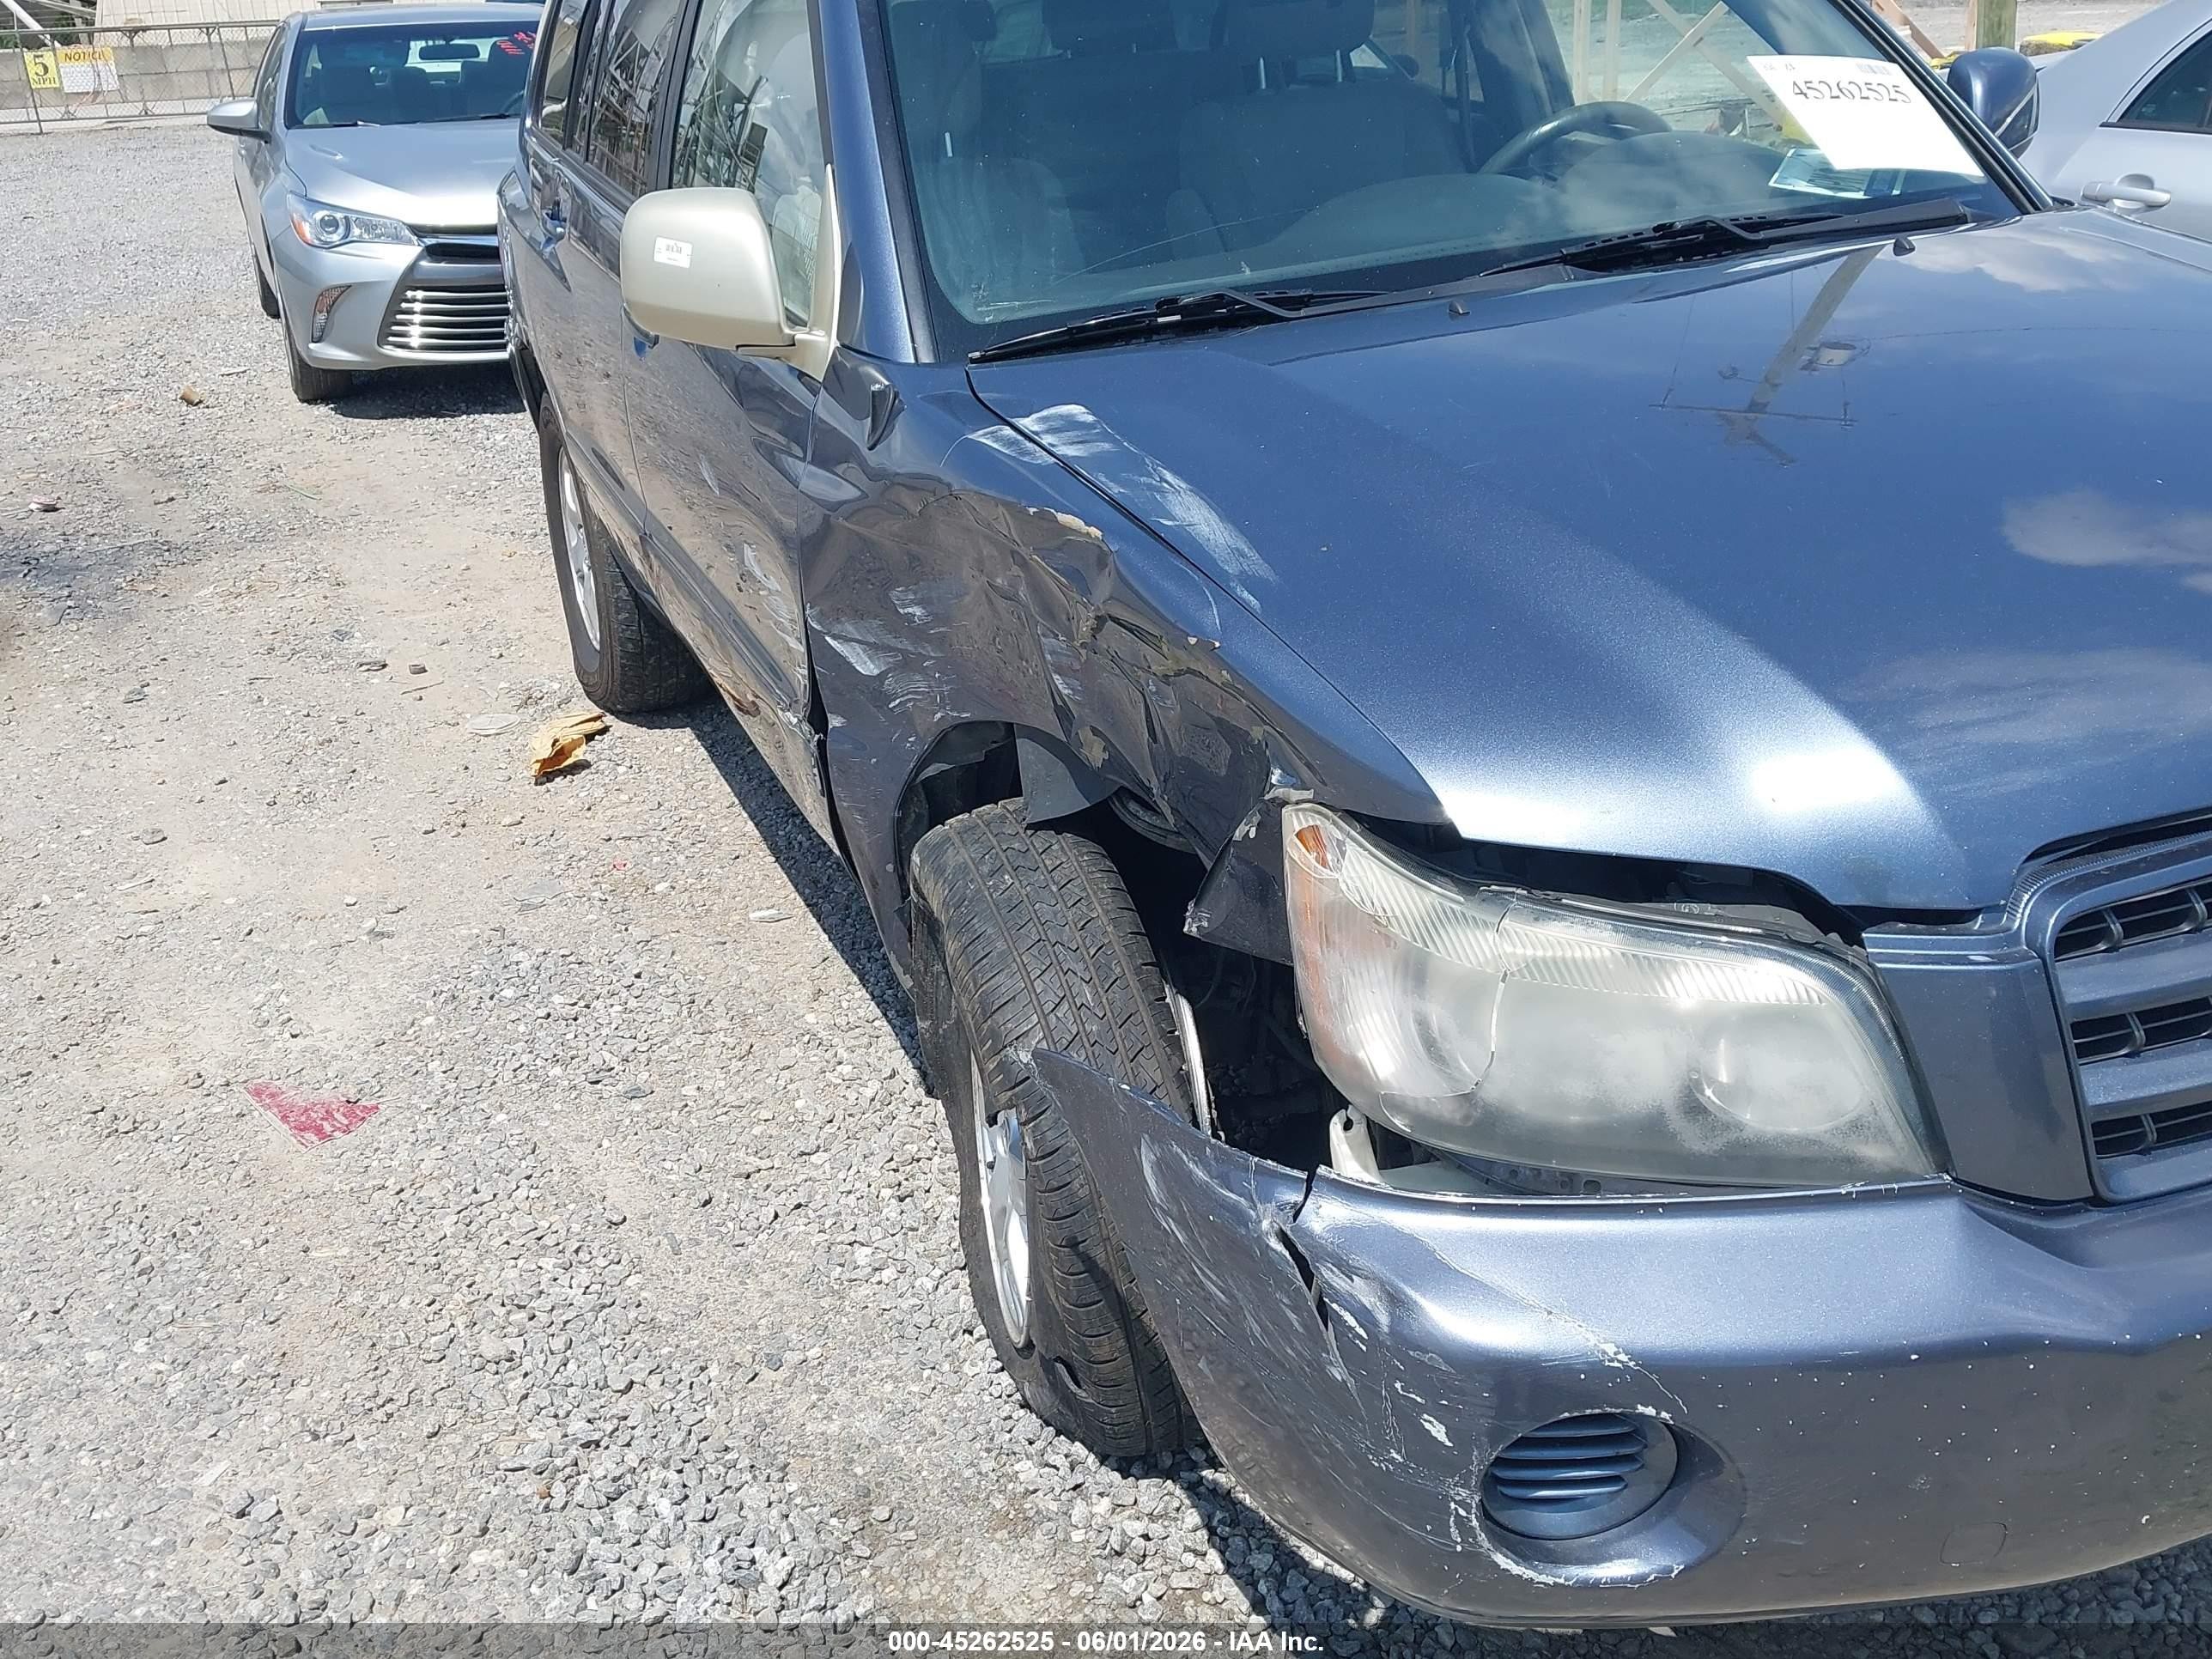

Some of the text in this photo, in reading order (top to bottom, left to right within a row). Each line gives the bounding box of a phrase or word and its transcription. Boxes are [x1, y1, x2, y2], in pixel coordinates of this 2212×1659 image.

[33, 53, 49, 77] 5
[31, 76, 57, 86] MPH
[1792, 80, 1911, 104] 45262525
